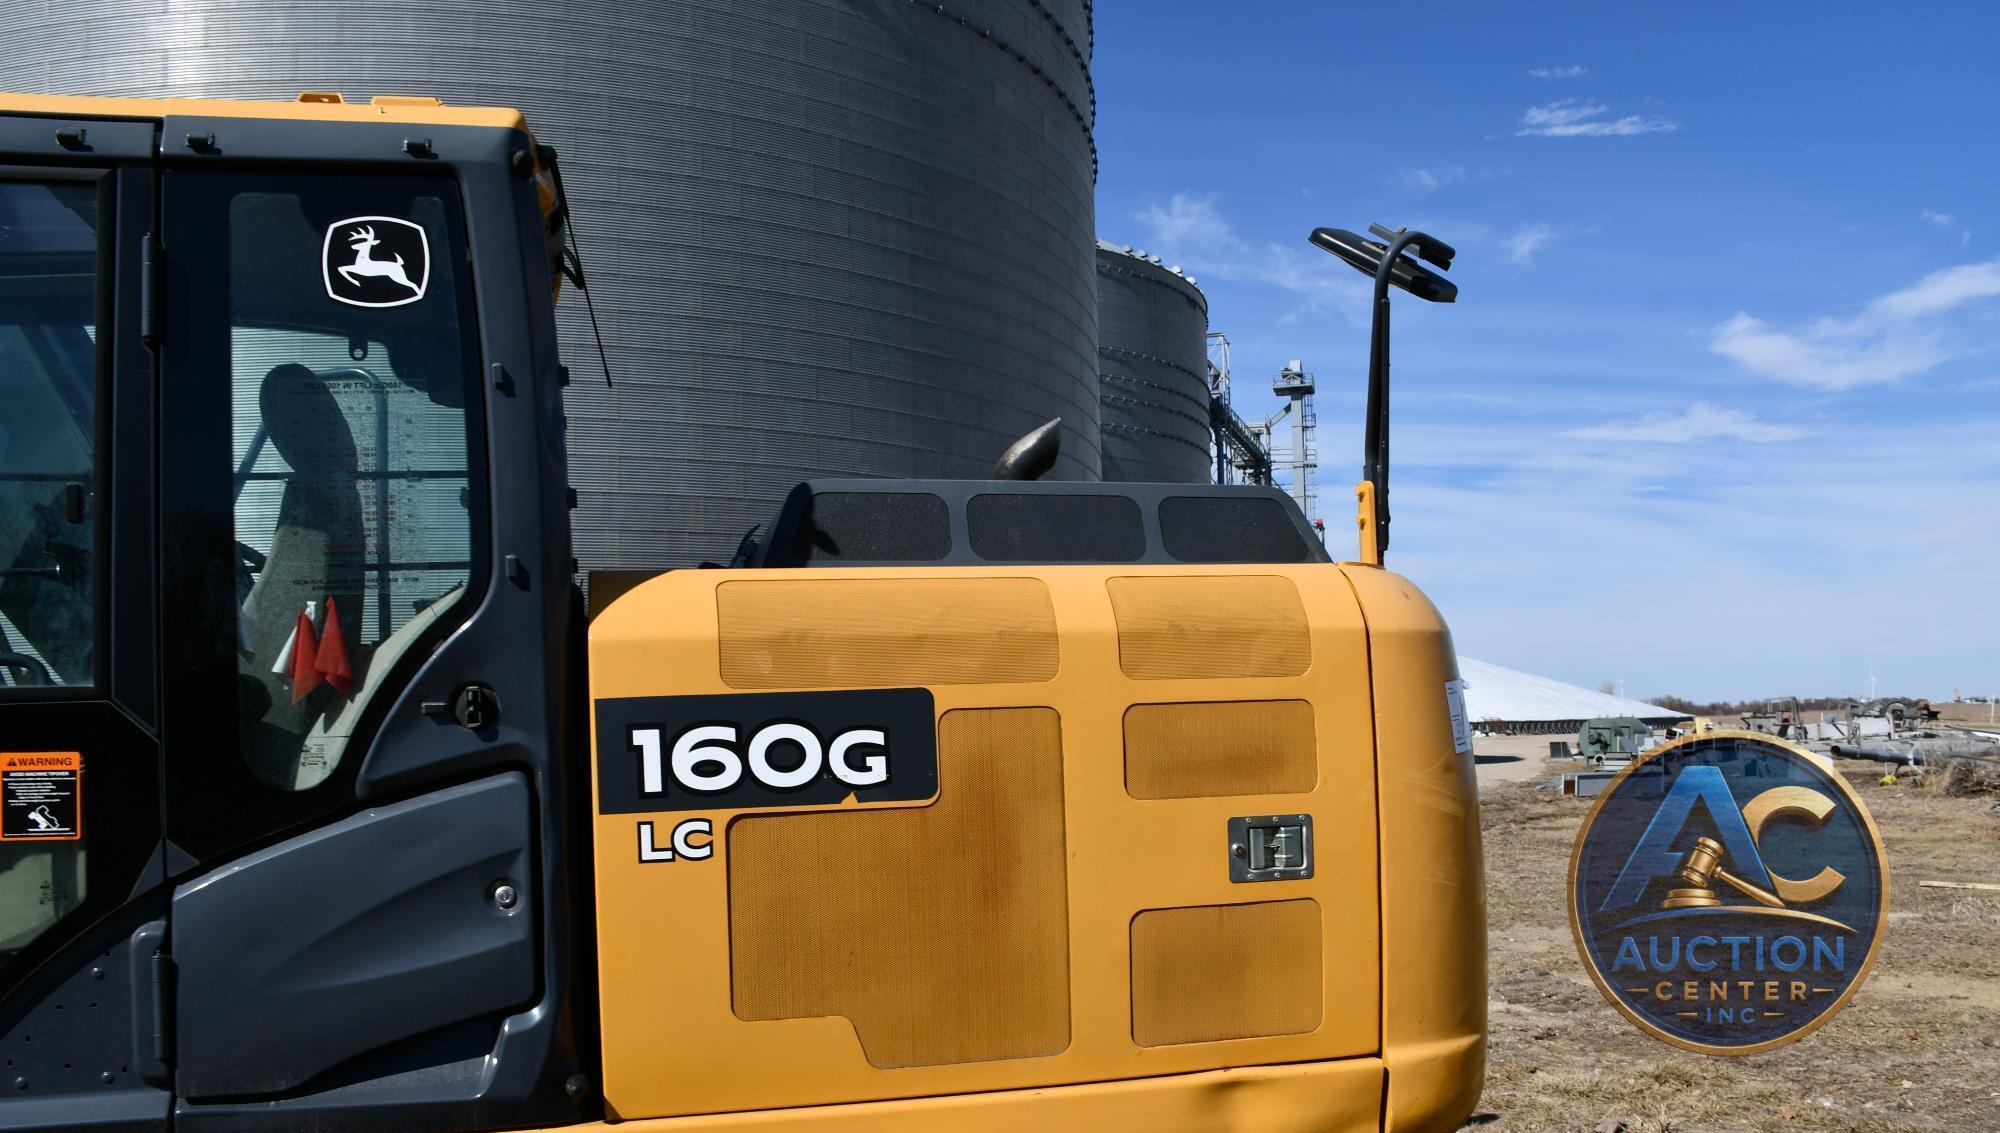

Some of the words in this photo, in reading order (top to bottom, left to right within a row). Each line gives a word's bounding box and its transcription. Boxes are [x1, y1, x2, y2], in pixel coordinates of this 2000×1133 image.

[18, 757, 72, 767] WARNING
[630, 721, 889, 794] 160G
[638, 819, 713, 863] LC
